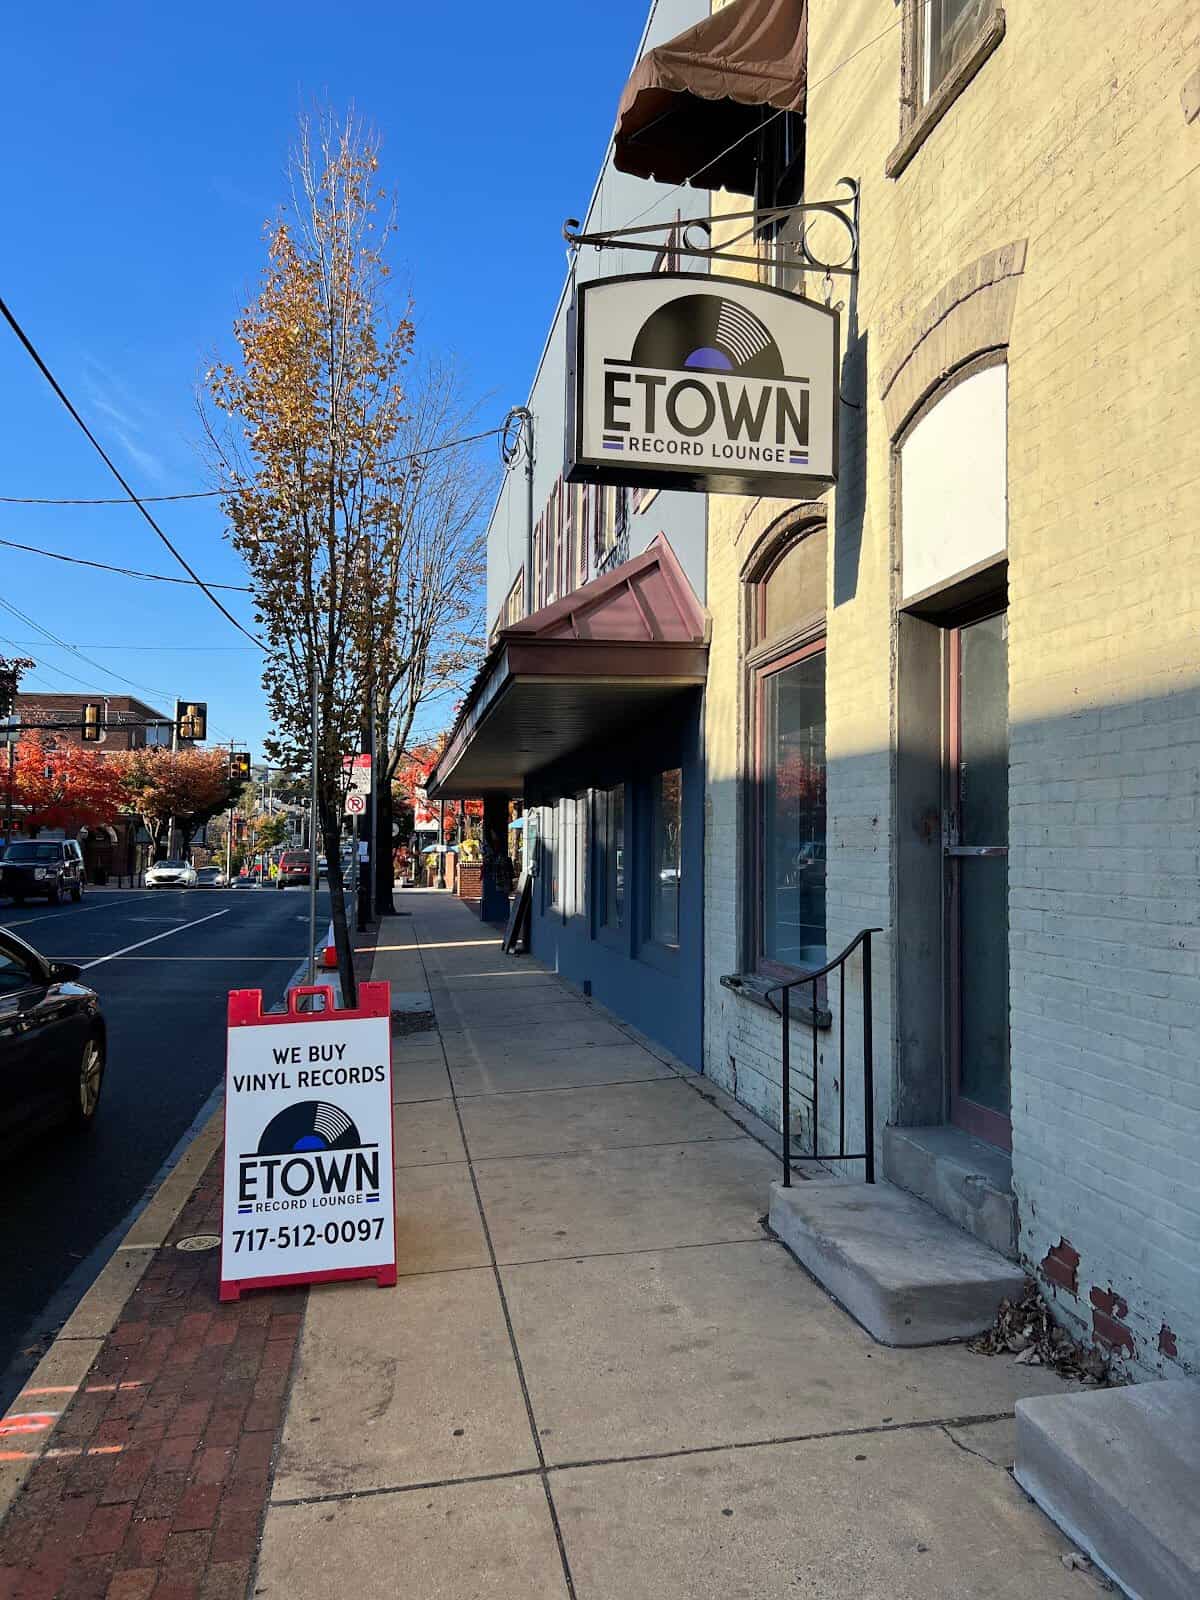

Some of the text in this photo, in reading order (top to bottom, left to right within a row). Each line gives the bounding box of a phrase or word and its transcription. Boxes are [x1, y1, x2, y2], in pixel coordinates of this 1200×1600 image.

[603, 370, 810, 447] ETOWN
[628, 436, 785, 463] RECORD LOUNGE
[272, 1043, 347, 1065] WE BUY
[233, 1065, 385, 1093] VINYL RECORDS
[238, 1152, 380, 1202] ETOWN
[255, 1193, 363, 1213] RECORD LOUNGE
[232, 1217, 385, 1253] 717-512-0097
